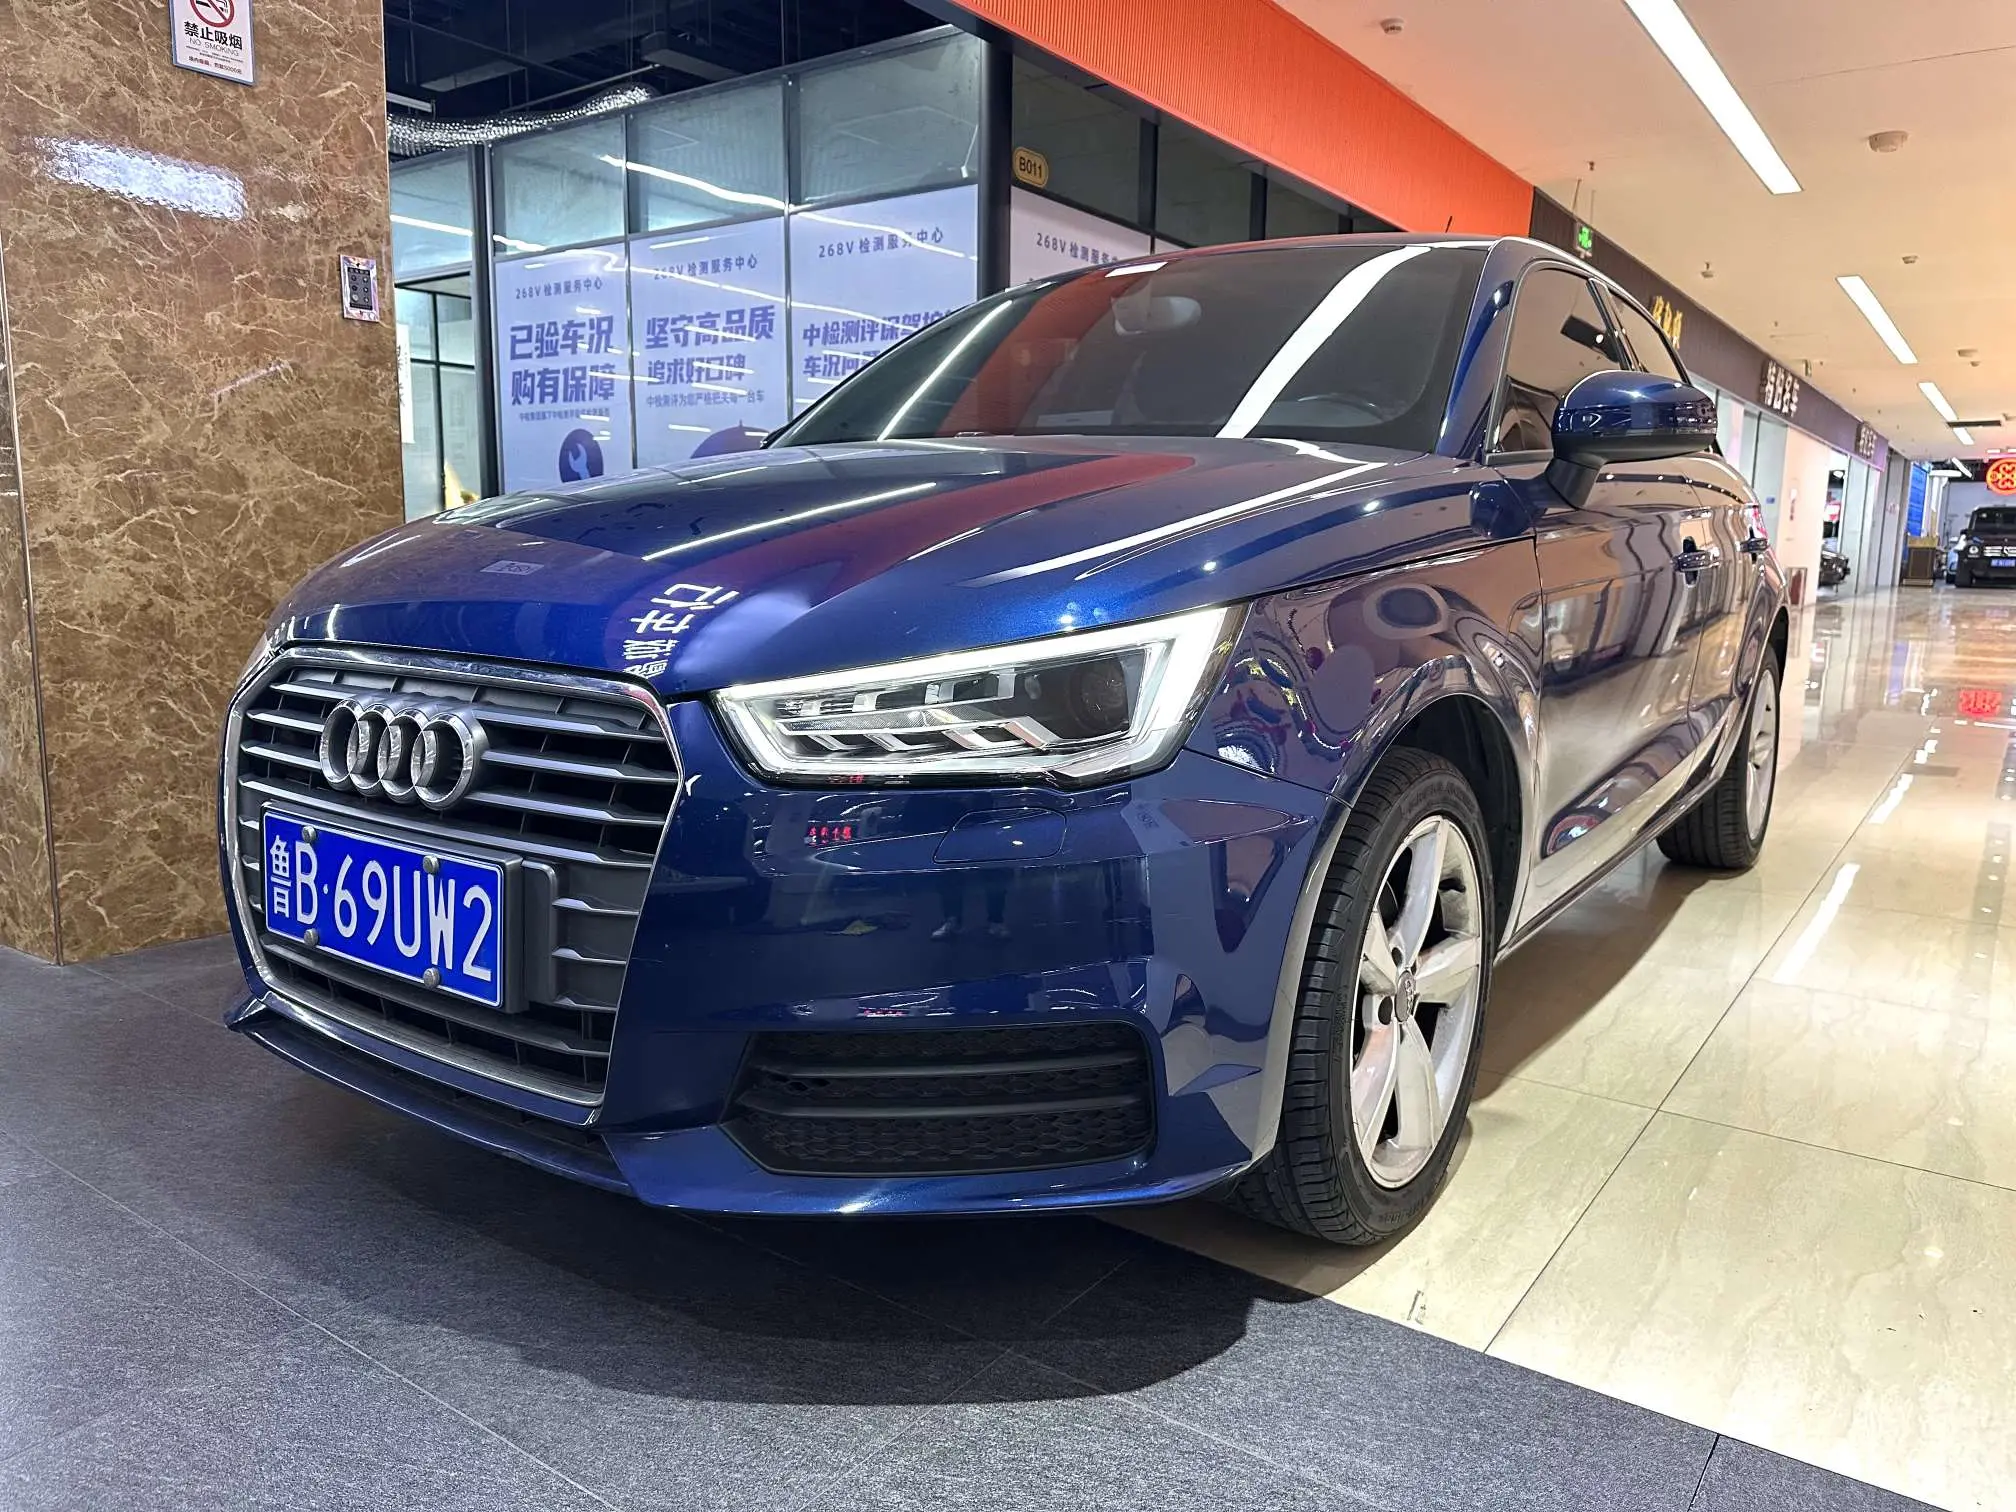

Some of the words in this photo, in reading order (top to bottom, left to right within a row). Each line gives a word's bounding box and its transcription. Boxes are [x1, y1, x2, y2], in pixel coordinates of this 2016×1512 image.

[184, 20, 243, 50] 禁止吸烟
[189, 37, 201, 47] NO
[204, 41, 240, 57] SMOKING
[1019, 156, 1042, 179] B011
[509, 315, 614, 361] 已验车况
[644, 304, 776, 350] 坚守高品质
[511, 362, 616, 406] 购有保障
[647, 353, 747, 386] 追求好口碑
